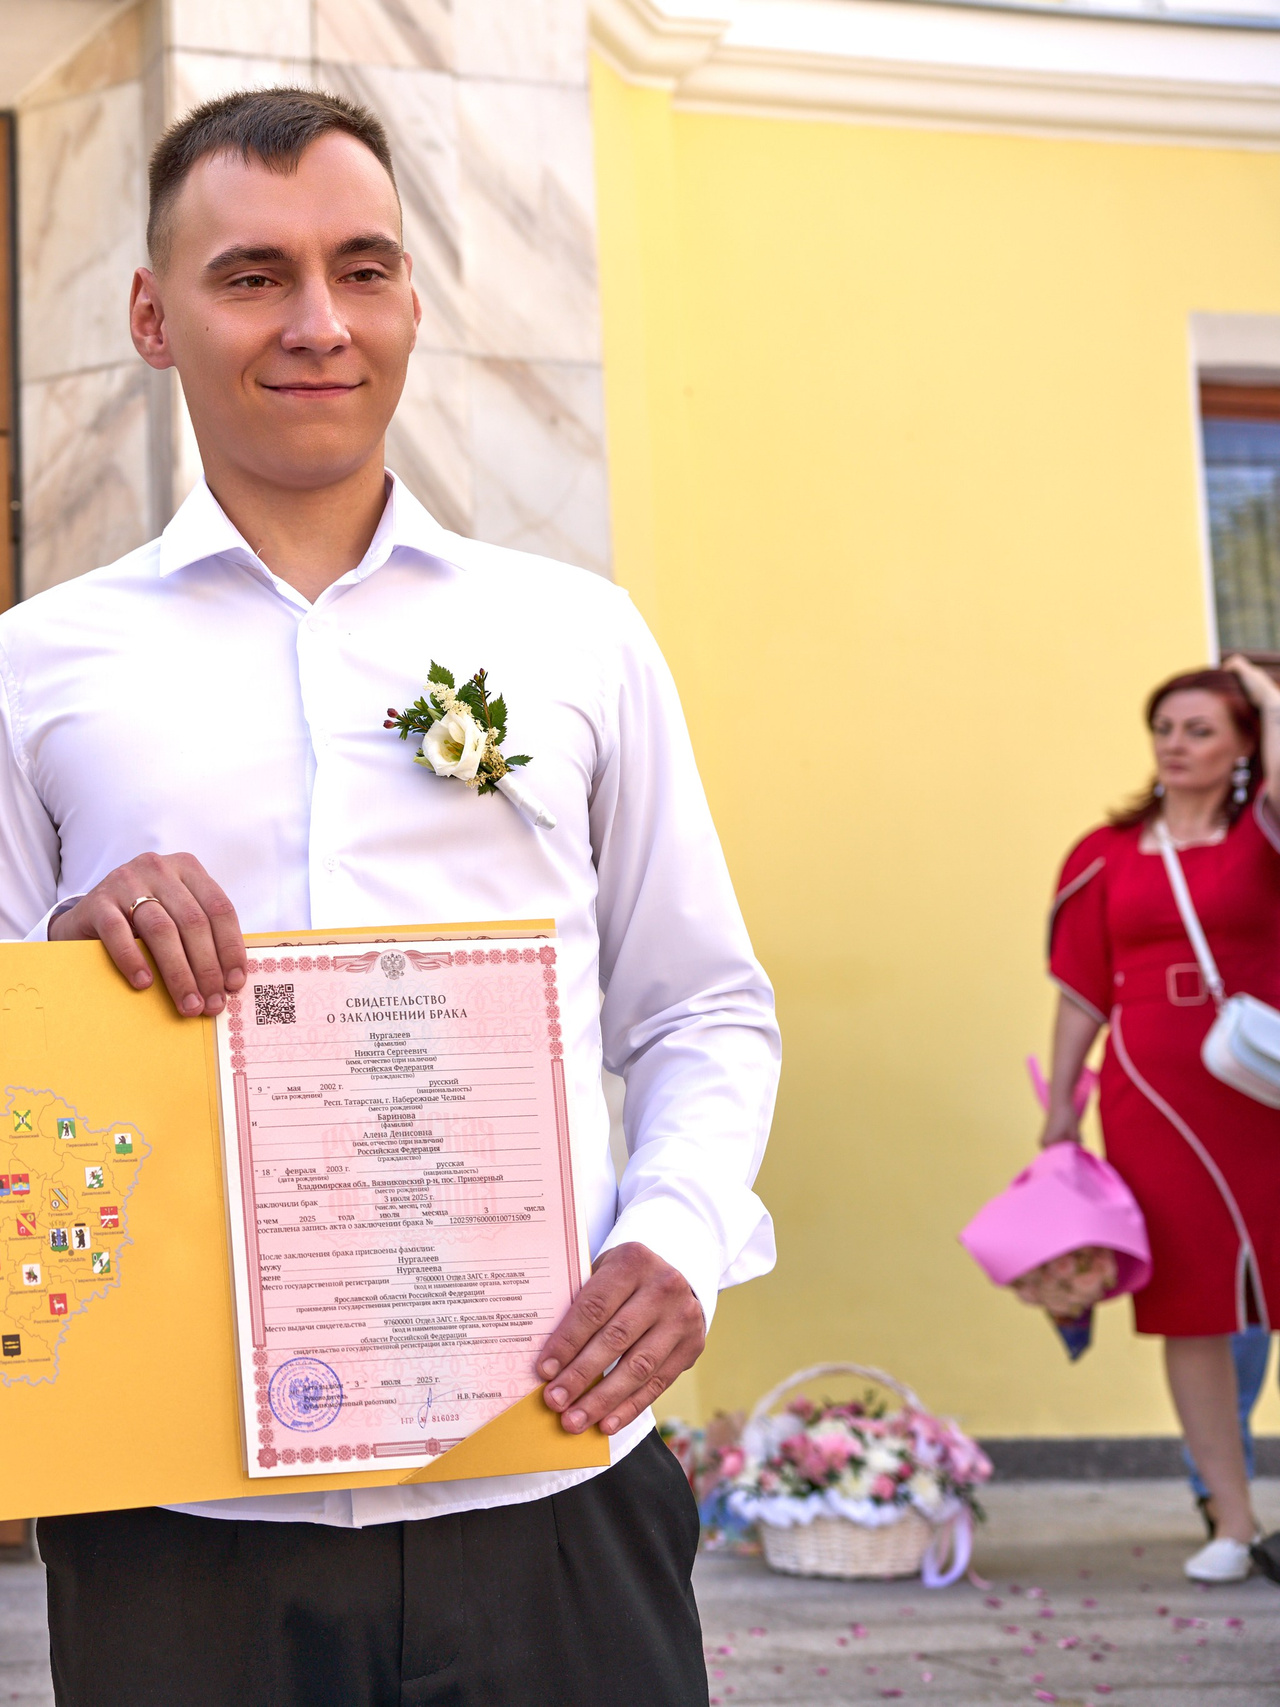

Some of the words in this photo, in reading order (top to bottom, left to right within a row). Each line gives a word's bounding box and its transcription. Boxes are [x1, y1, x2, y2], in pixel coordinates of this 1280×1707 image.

[346, 994, 446, 1008] СВИДЕТЕЛЬСТВО
[327, 1014, 336, 1023] О
[340, 1010, 426, 1023] ЗАКЛЮЧЕНИИ
[430, 1009, 467, 1019] БРАКА
[369, 1032, 411, 1040] Нургалеев
[354, 1049, 385, 1057] Никита
[387, 1048, 427, 1056] Сергеевич
[429, 1078, 458, 1087] русский
[417, 1086, 472, 1094] (национальность)
[344, 1098, 383, 1106] Татарстан,
[393, 1095, 439, 1104] Набережные
[378, 1113, 416, 1121] Баринова
[390, 1130, 432, 1138] Денисовна
[357, 1148, 399, 1156] Российская
[378, 1154, 422, 1162] (гражданство)
[285, 1167, 316, 1175] февраля
[423, 1168, 478, 1176] (национальность)
[297, 1182, 352, 1191] Владимирская
[371, 1178, 425, 1187] Вязниковский
[458, 1175, 503, 1183] Приозерный
[255, 1201, 299, 1209] заключили
[300, 1200, 318, 1208] брак
[258, 1226, 300, 1234] составлена
[354, 1220, 400, 1229] заключении
[403, 1219, 423, 1227] брака
[355, 1248, 397, 1256] присвоены
[398, 1256, 439, 1264] Нургалеев
[397, 1266, 442, 1274] Нургалеева
[284, 1280, 343, 1290] государственной
[345, 1279, 389, 1287] регистрации
[491, 1271, 525, 1279] Ярославля
[334, 1295, 378, 1304] Ярославской
[380, 1293, 407, 1301] области
[409, 1291, 447, 1299] Российской
[448, 1289, 485, 1297] Федерации
[296, 1305, 336, 1313] произведена
[338, 1302, 390, 1310] государственная
[316, 1321, 366, 1330] свидетельства
[383, 1318, 413, 1326] 97600001
[415, 1317, 435, 1325] Отдел
[460, 1314, 494, 1322] Ярославля
[496, 1312, 538, 1320] Ярославской
[482, 1321, 509, 1329] которым
[389, 1334, 429, 1342] Российской
[430, 1332, 467, 1340] Федерации
[346, 1343, 399, 1353] государственной
[456, 1338, 498, 1346] гражданского
[472, 1391, 502, 1399] Рыбкина
[432, 1414, 460, 1422] 816023
